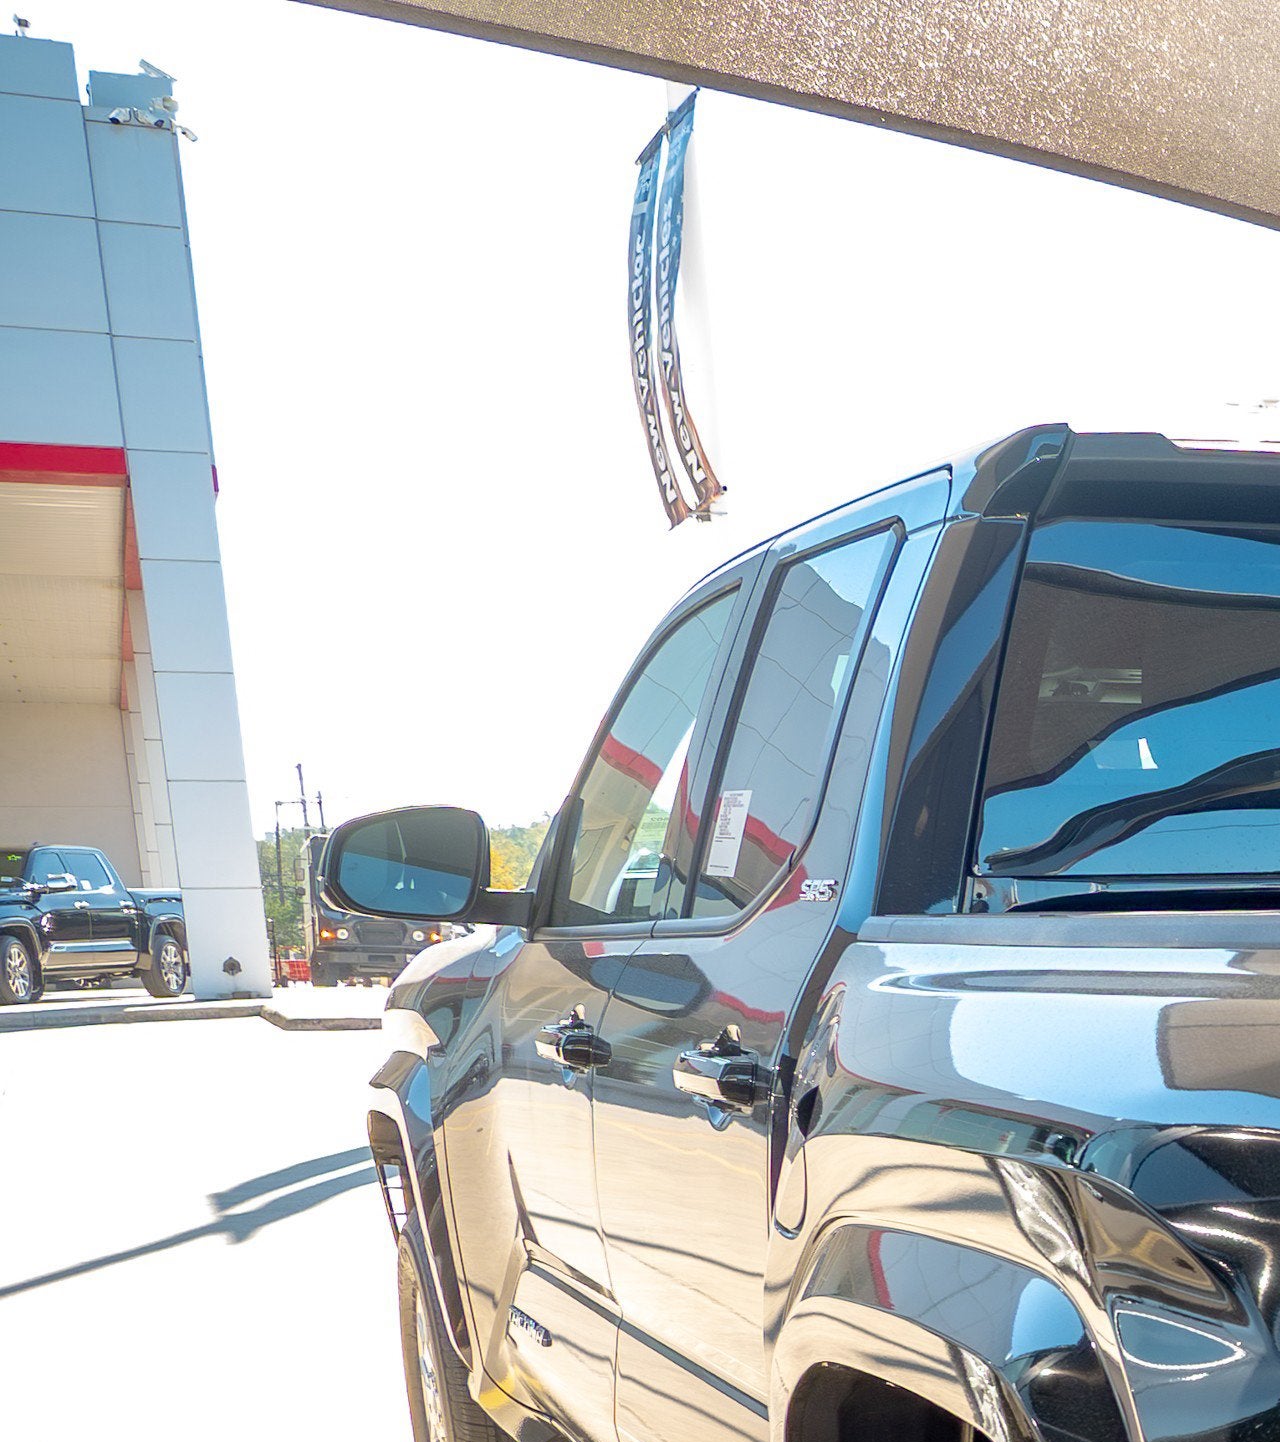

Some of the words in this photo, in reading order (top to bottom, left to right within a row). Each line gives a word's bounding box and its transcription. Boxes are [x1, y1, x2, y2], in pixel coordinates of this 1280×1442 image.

[647, 414, 678, 504] New
[671, 390, 707, 484] New
[799, 879, 839, 902] SR5
